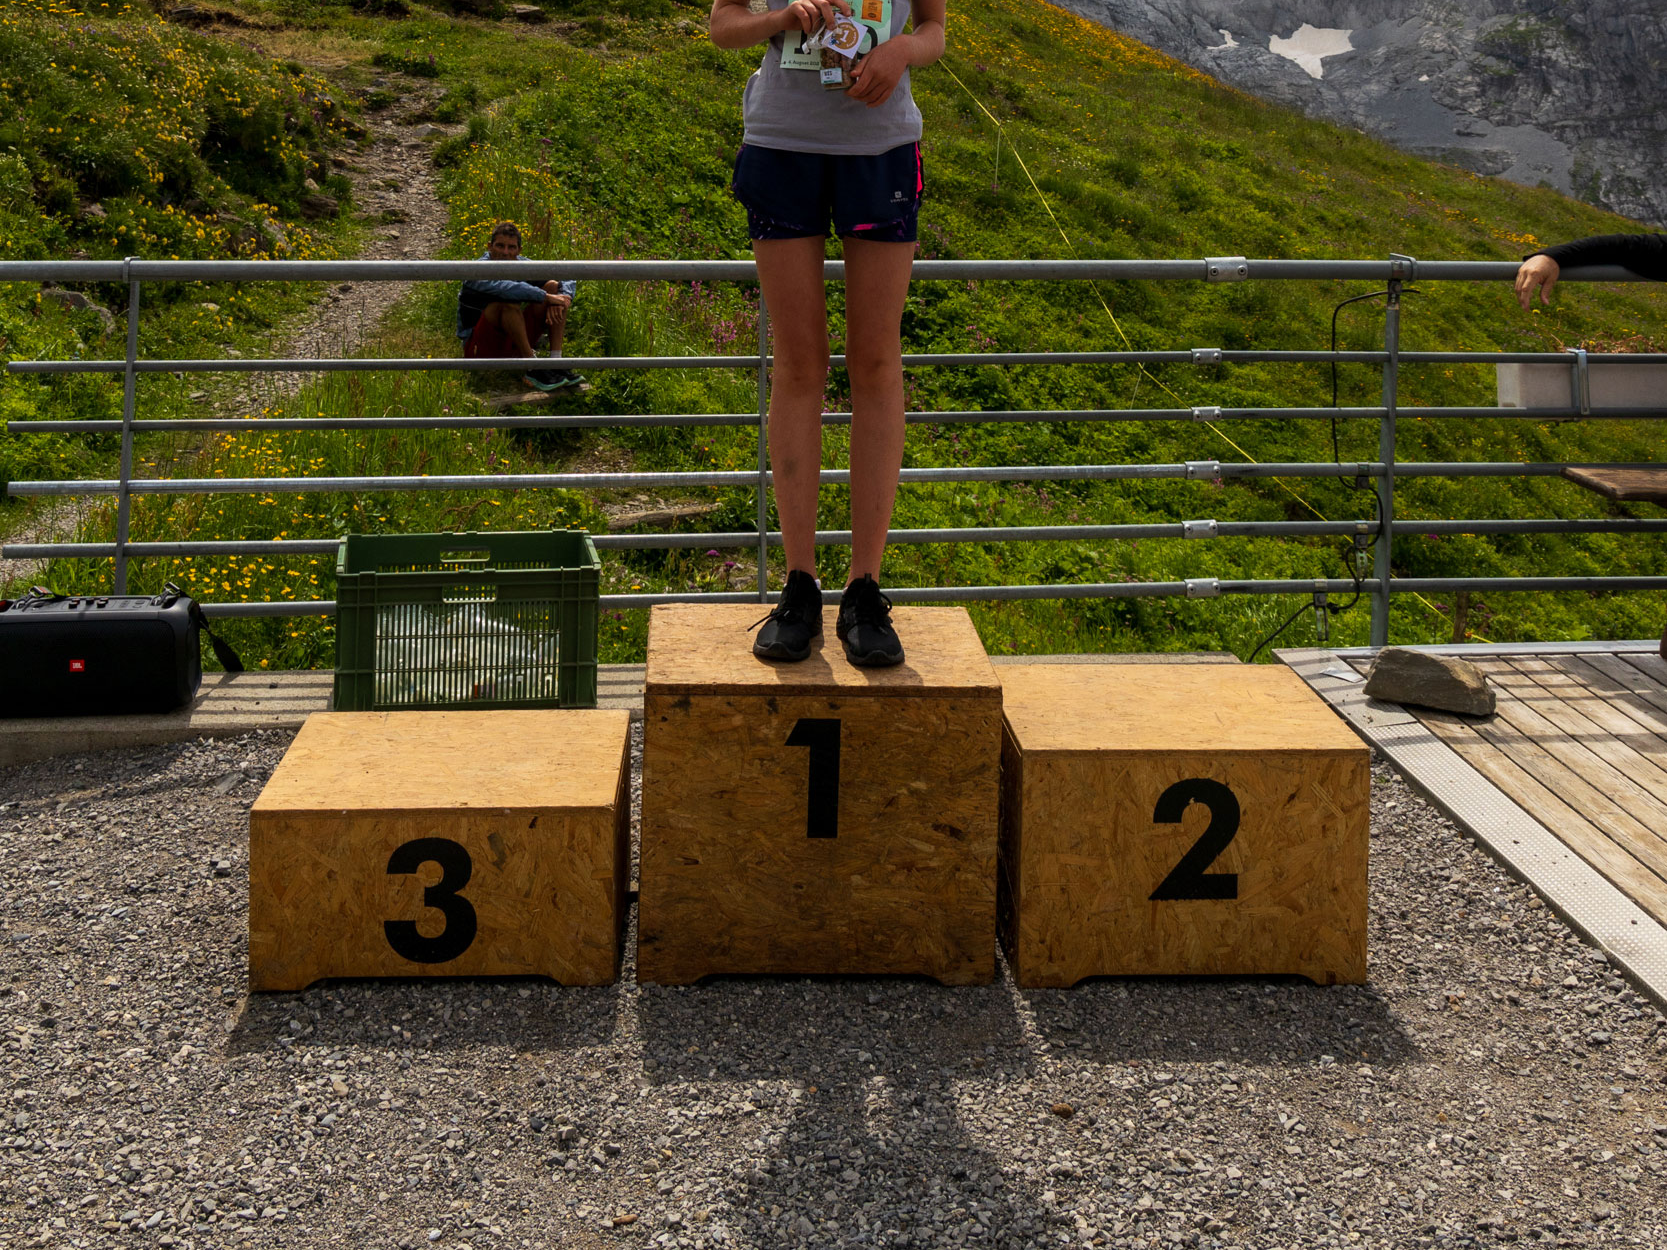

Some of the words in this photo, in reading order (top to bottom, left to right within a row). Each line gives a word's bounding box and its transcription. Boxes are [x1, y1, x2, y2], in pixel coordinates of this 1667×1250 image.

[840, 30, 850, 43] 1
[784, 718, 841, 838] 1
[1148, 778, 1240, 901] 2
[384, 837, 478, 965] 3
